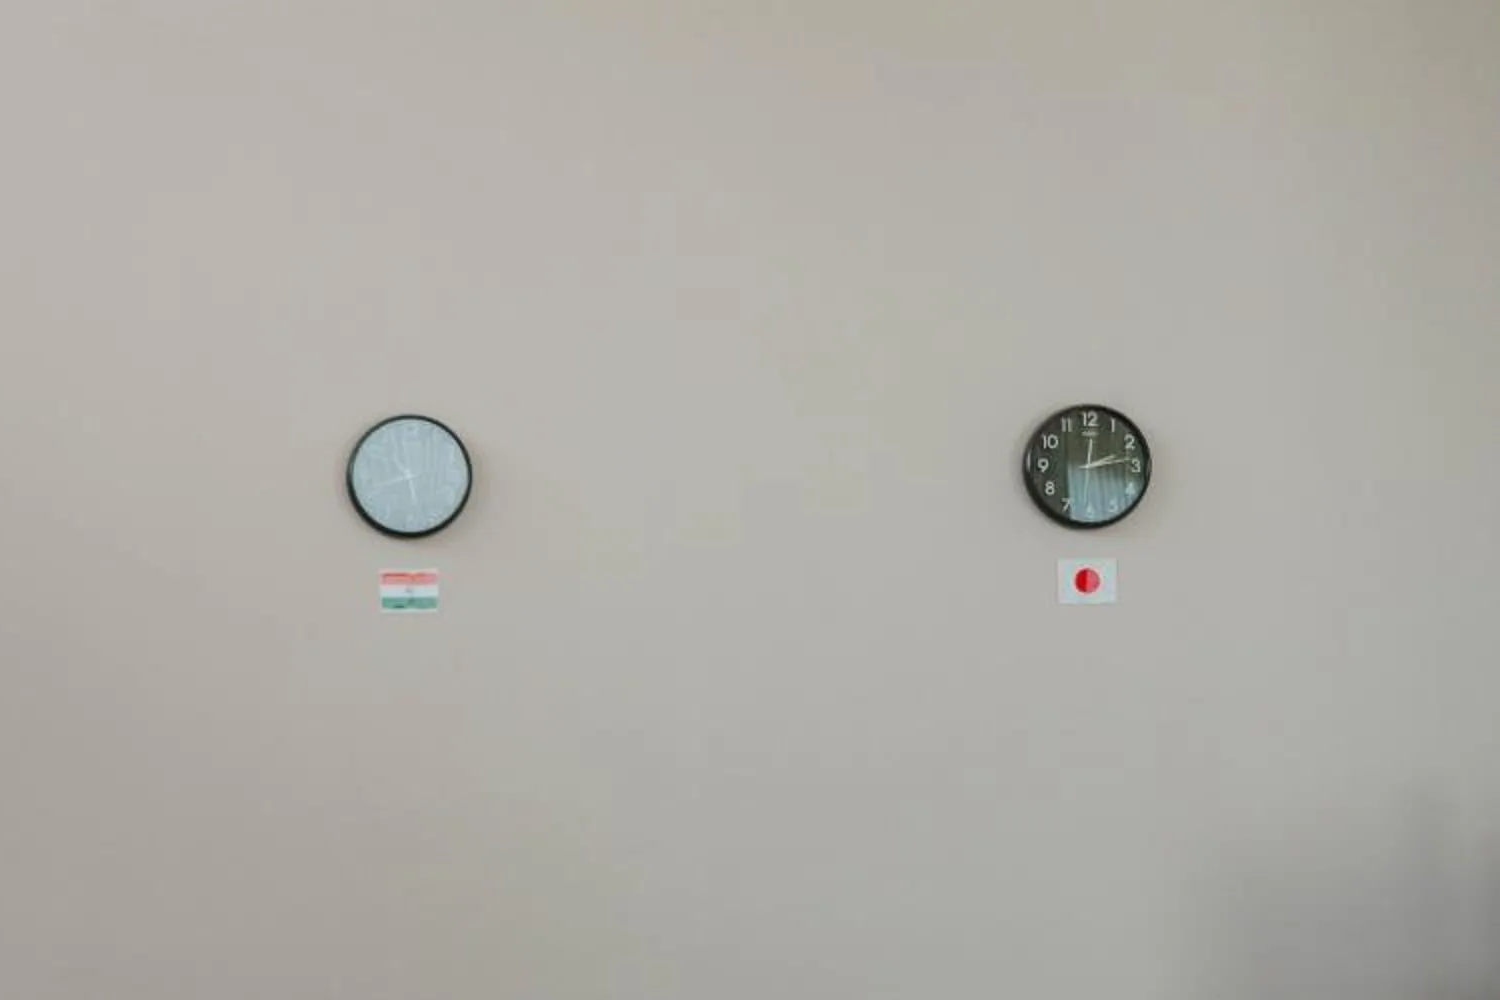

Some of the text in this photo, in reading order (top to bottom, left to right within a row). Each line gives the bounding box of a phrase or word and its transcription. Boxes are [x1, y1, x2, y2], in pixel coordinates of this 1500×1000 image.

[1061, 417, 1073, 432] 11
[1082, 411, 1098, 427] 12
[1110, 418, 1116, 433] 1
[1042, 434, 1059, 449] 10
[1124, 433, 1136, 450] 2
[1037, 458, 1049, 473] 9
[1131, 458, 1141, 473] 3
[1045, 481, 1055, 496] 8
[1060, 497, 1071, 512] 7
